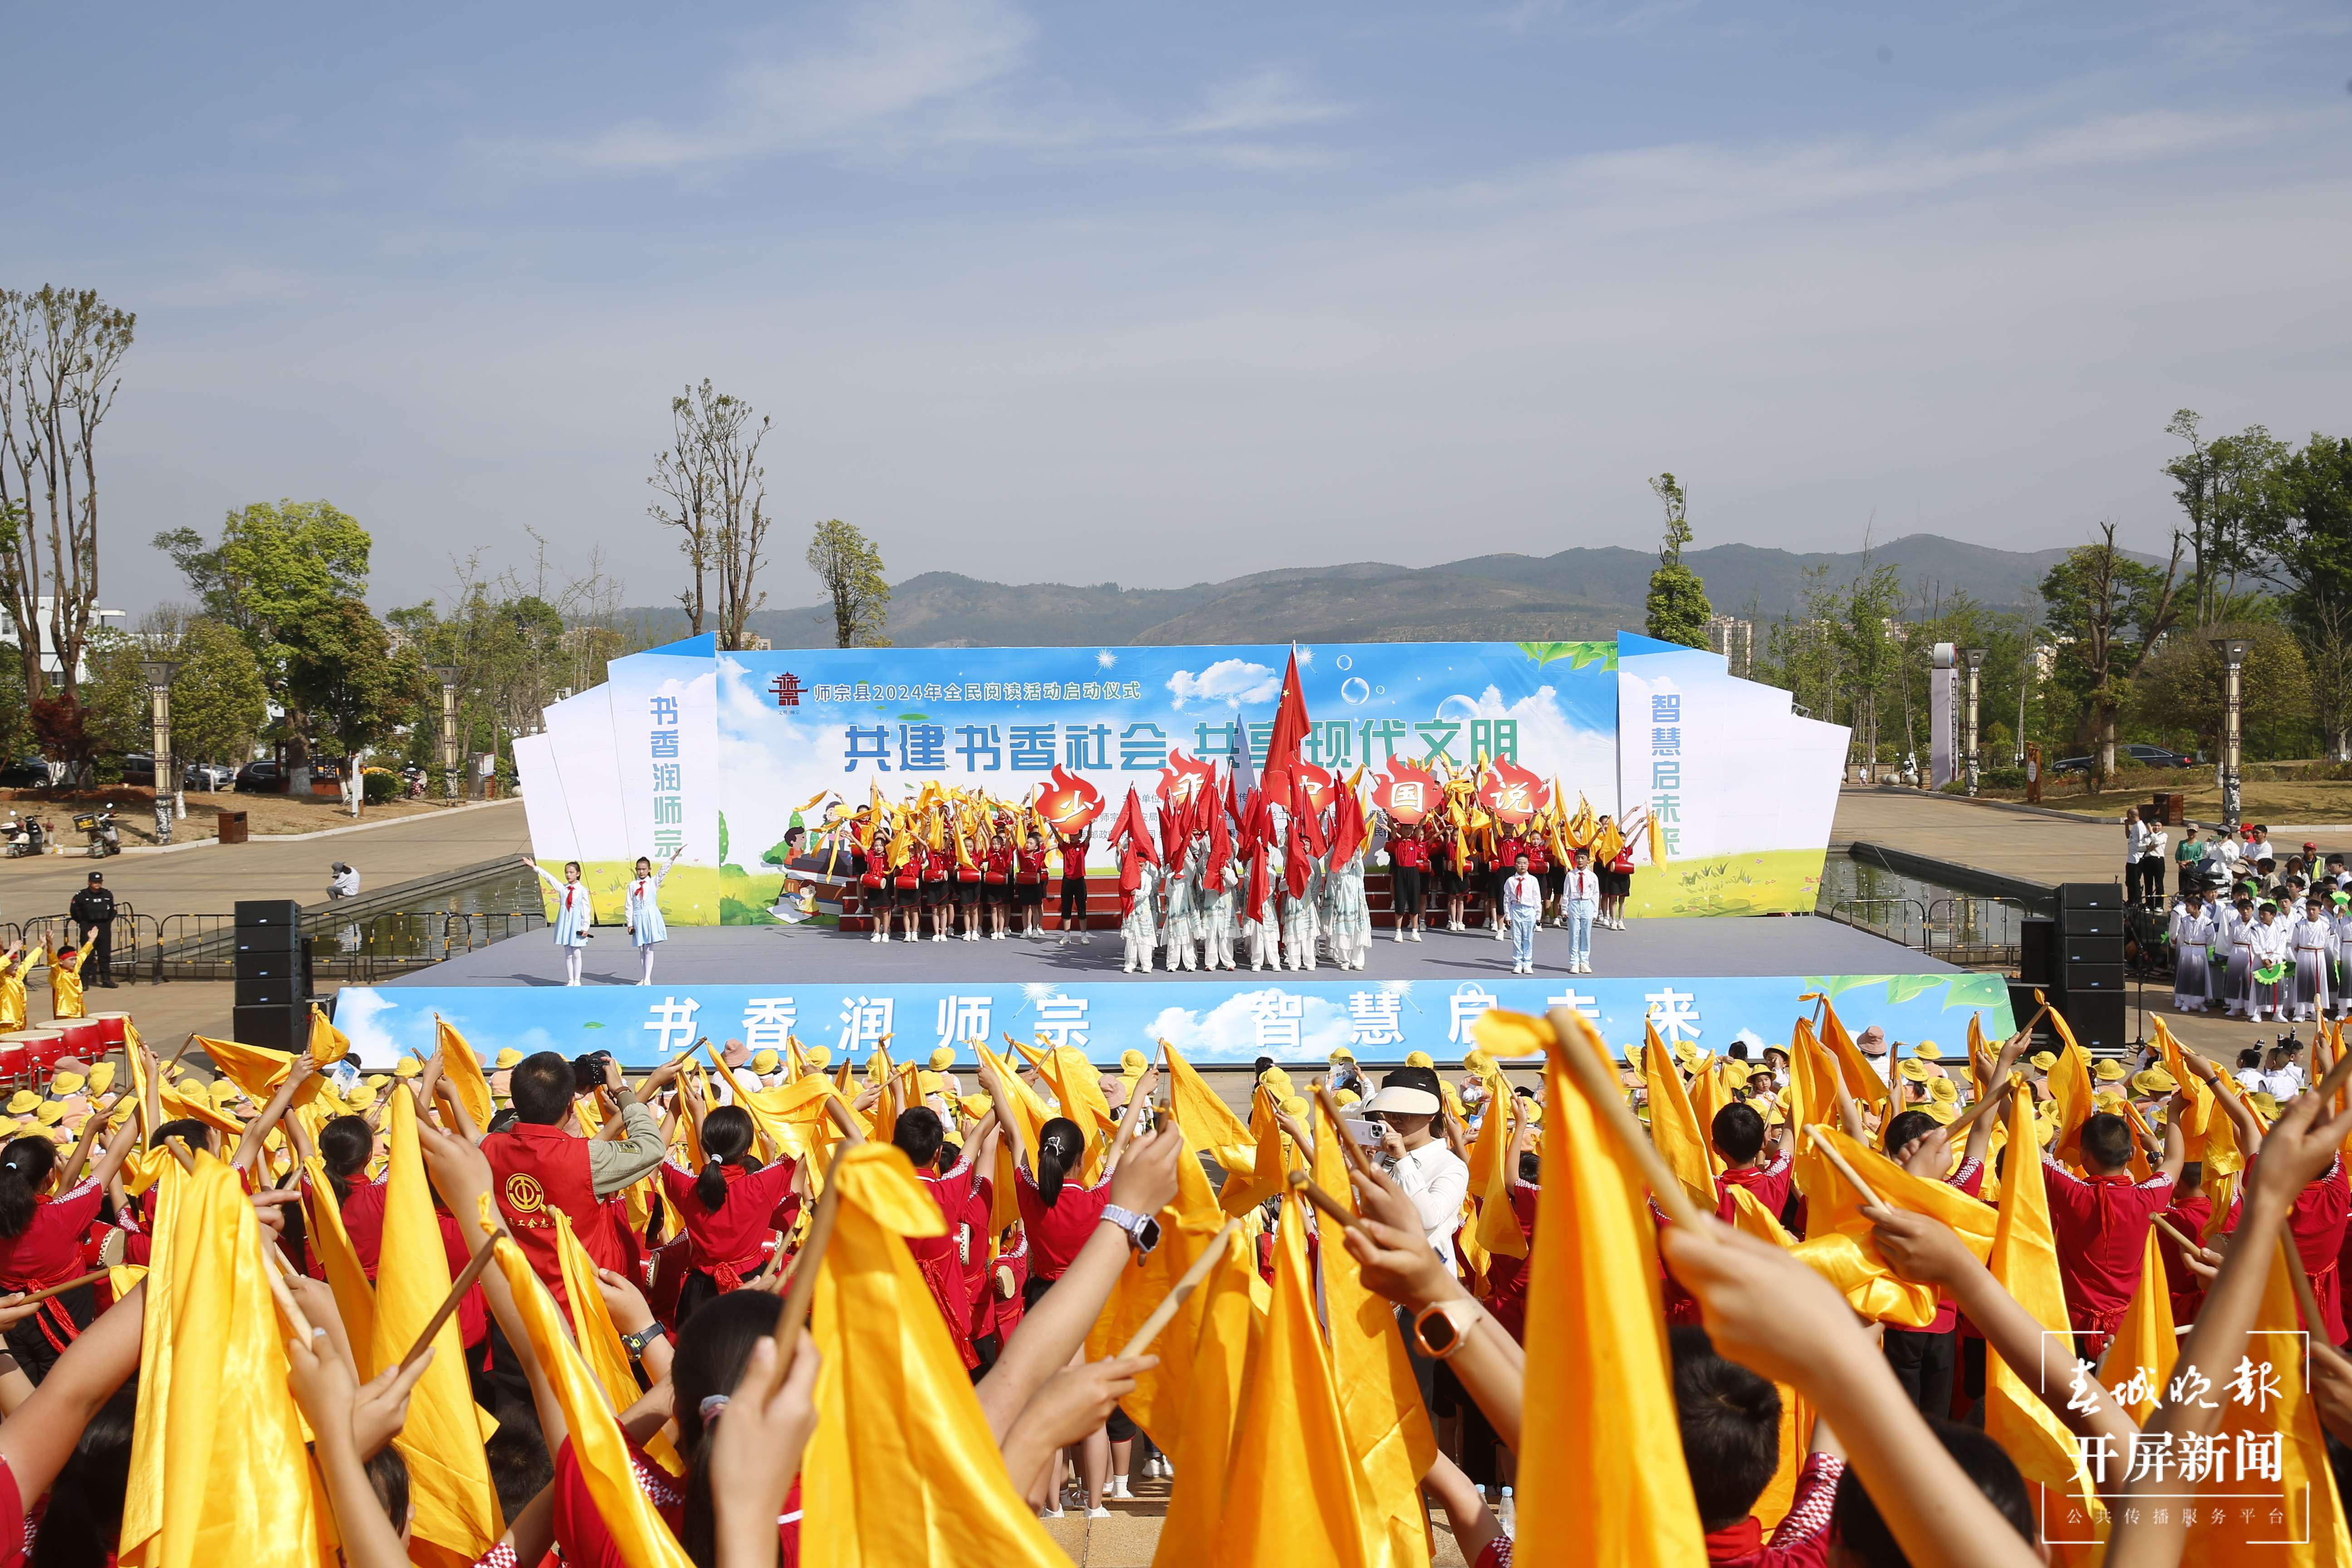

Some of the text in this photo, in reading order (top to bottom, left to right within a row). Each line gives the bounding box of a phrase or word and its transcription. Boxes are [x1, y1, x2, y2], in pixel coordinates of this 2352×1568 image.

[813, 682, 1141, 702] 师宗县2024年全民阅读活动启动仪式
[844, 723, 1166, 772] 共建书香社会
[649, 696, 683, 858] 书香润师宗
[1651, 694, 1681, 855] 智慧启未来
[1051, 790, 1094, 823] 少
[1391, 782, 1425, 813] 国
[1491, 783, 1533, 813] 说
